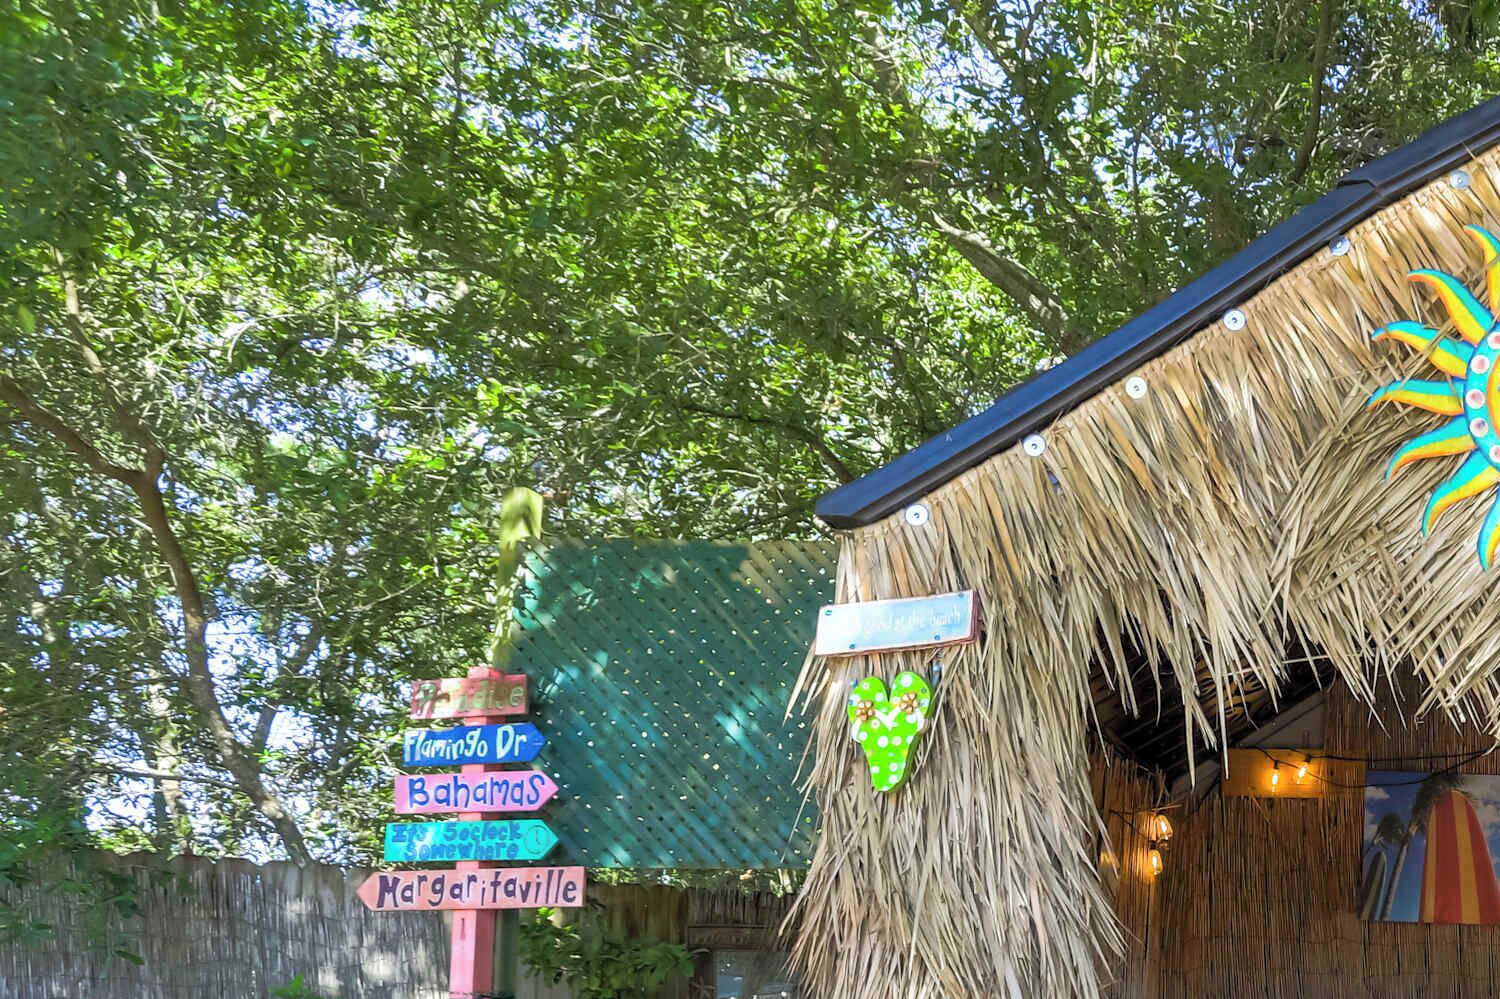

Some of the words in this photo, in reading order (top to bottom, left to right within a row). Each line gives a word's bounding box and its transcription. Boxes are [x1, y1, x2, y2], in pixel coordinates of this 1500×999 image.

[404, 727, 488, 762] Flamingo
[496, 725, 527, 759] Dr
[408, 774, 545, 808] Bahamas
[376, 869, 578, 908] Margaritaville
